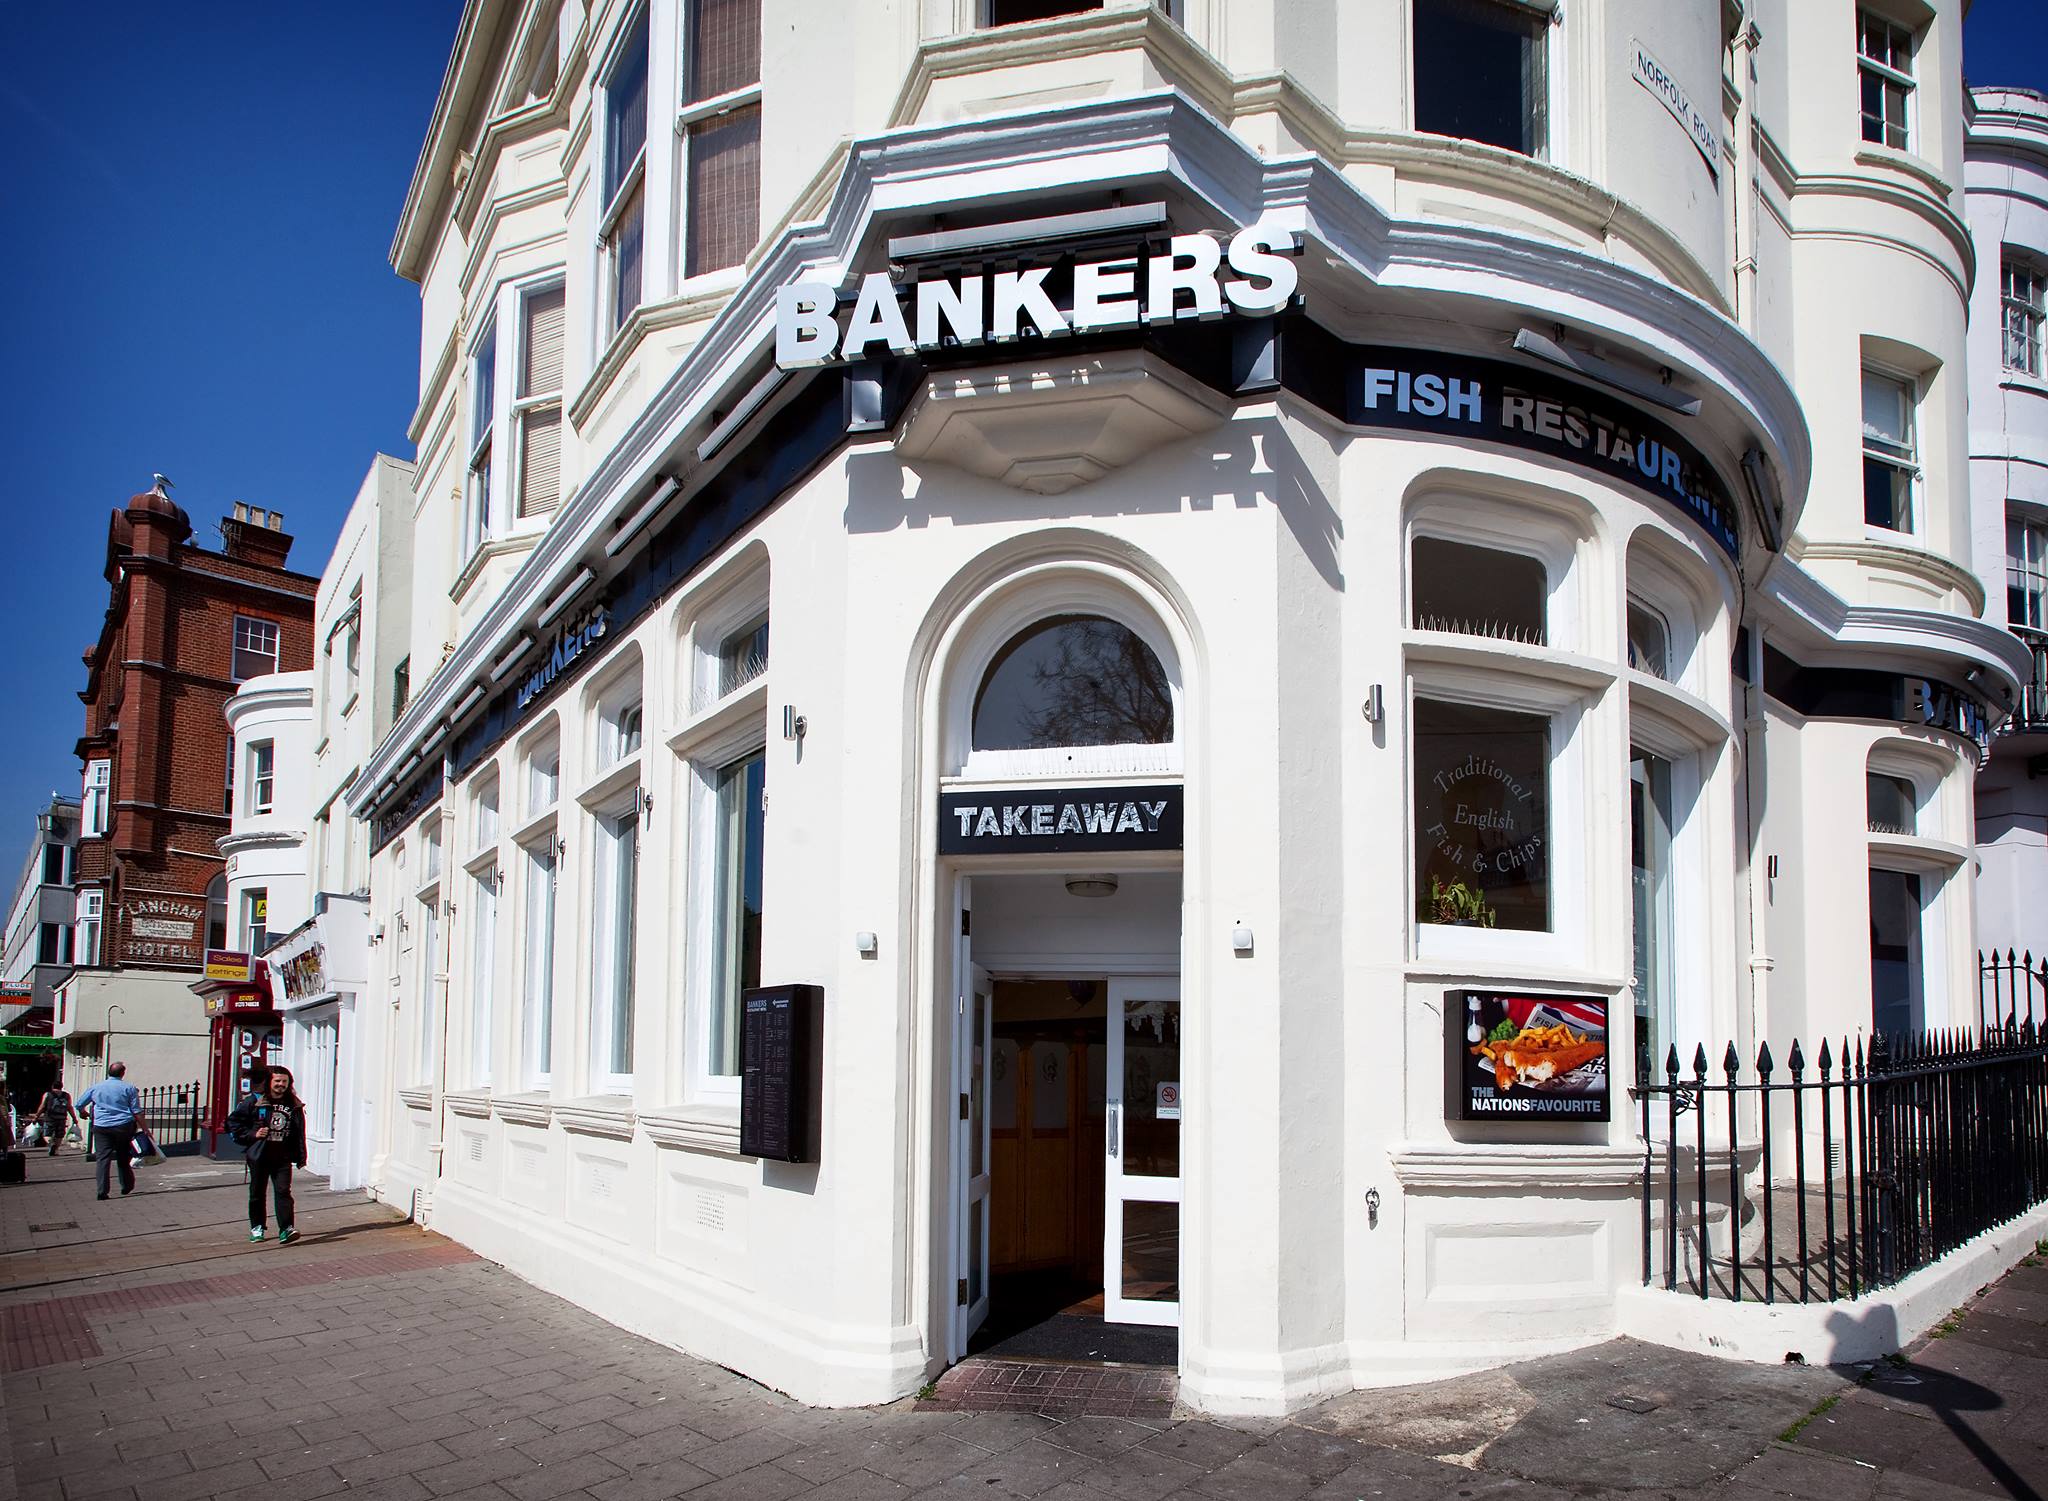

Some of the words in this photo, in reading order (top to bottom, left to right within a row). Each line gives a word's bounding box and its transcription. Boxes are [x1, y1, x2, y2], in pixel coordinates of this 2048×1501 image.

[1637, 50, 1689, 122] NORFOLK
[1693, 111, 1717, 159] ROAD
[776, 223, 1299, 371] BANKERS
[1364, 367, 1482, 423] FISH
[1433, 754, 1533, 801] Traditional
[954, 800, 1168, 837] TAKEAWAY
[1454, 803, 1515, 831] English
[1426, 822, 1464, 865] Fish
[1472, 852, 1488, 873] &
[1496, 834, 1542, 873] Chips
[127, 900, 202, 920] LANGHAM
[206, 967, 247, 978] Lettings
[213, 954, 243, 963] Sales
[1471, 1086, 1494, 1098] THE
